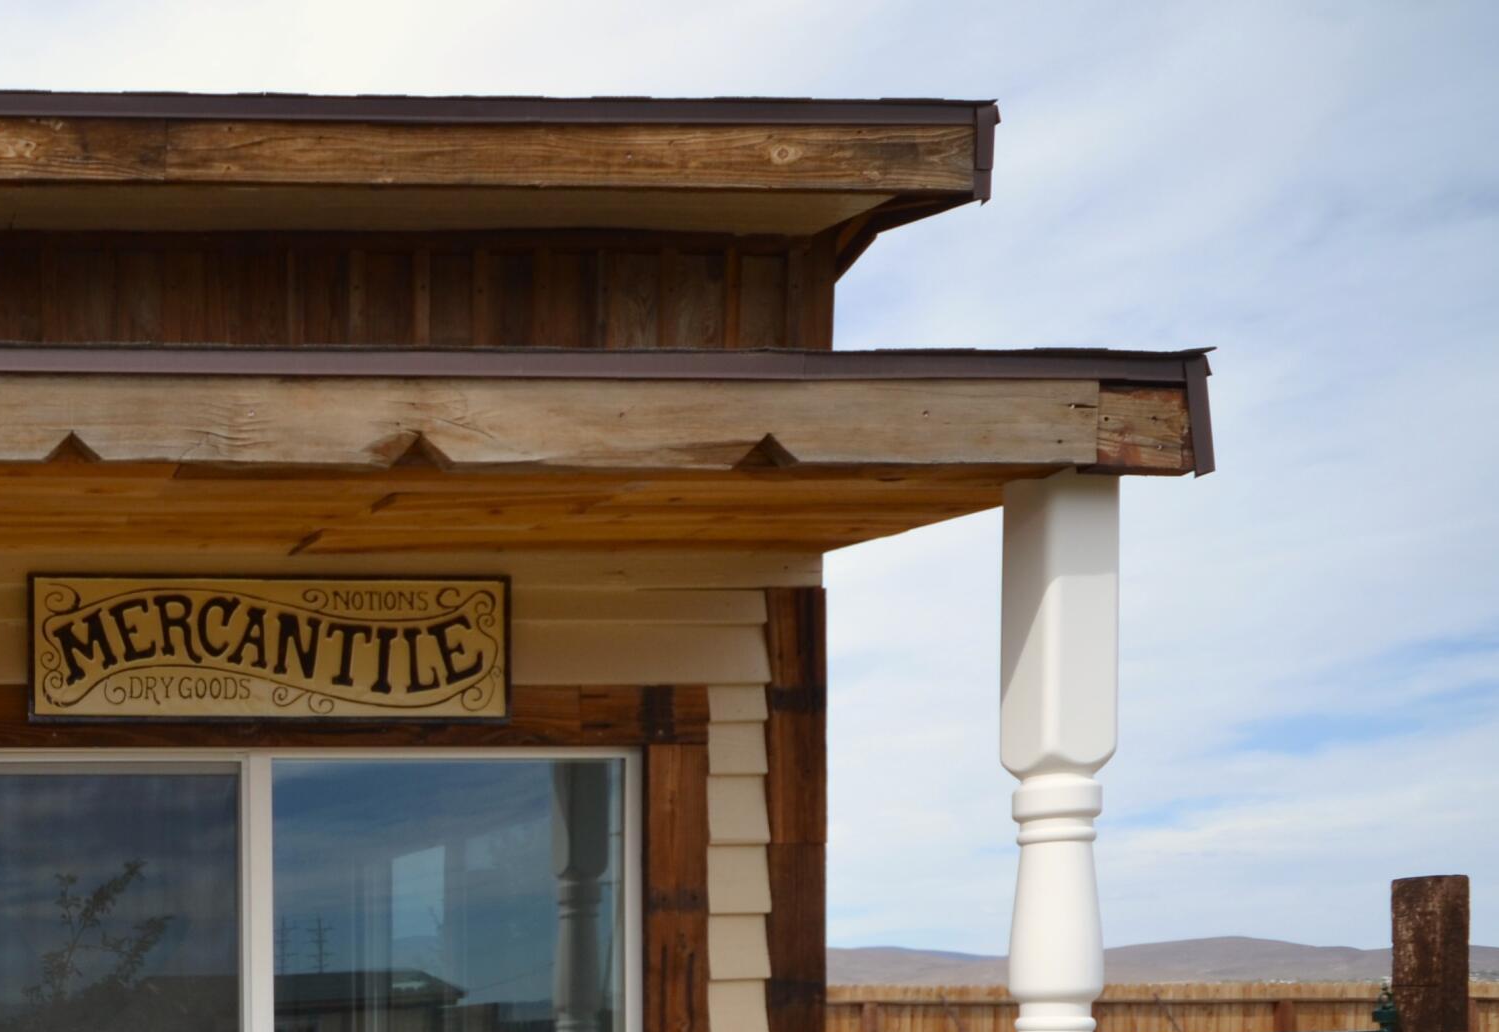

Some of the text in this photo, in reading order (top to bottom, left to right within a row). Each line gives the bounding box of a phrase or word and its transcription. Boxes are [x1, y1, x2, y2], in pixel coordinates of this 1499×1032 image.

[332, 590, 429, 612] NOTIONS
[52, 593, 484, 695] MERCANTILE
[129, 676, 252, 704] DRY GOODS
